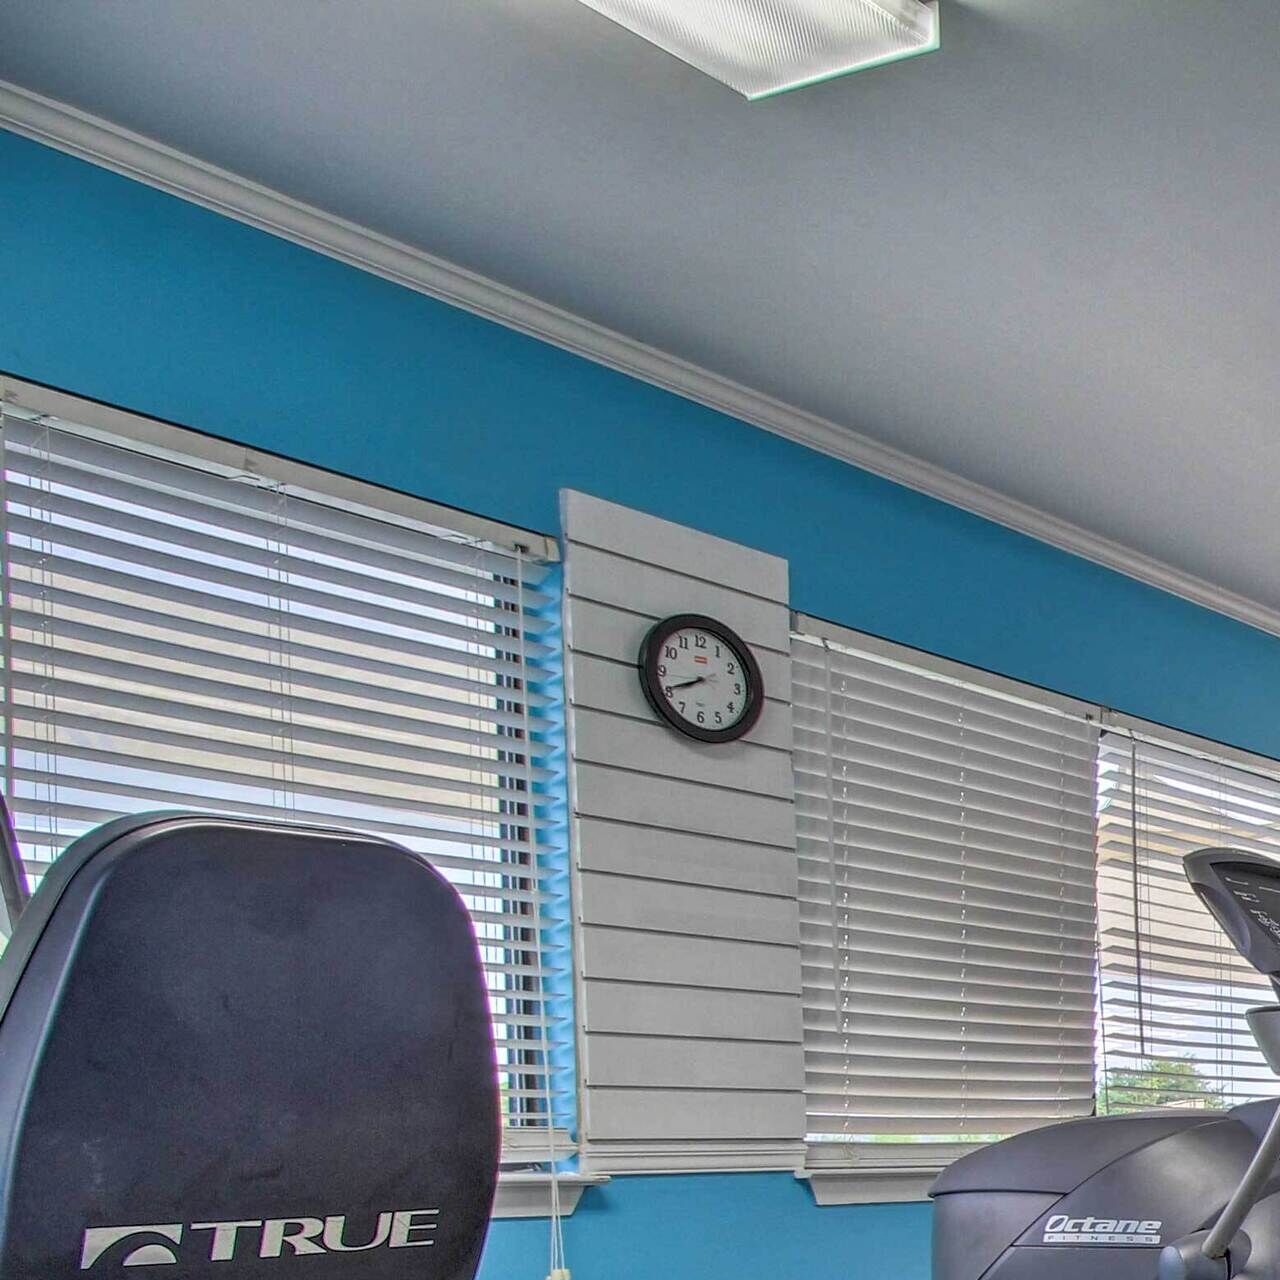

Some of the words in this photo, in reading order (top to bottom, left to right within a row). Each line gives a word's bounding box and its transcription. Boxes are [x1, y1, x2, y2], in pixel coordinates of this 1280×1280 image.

[679, 635, 689, 650] 11
[694, 634, 707, 649] 12
[665, 646, 678, 660] 10
[715, 645, 721, 659] 1
[658, 664, 667, 678] 9
[727, 662, 735, 675] 2
[665, 685, 674, 699] 8
[733, 683, 741, 696] 3
[678, 701, 686, 714] 7
[726, 701, 735, 714] 4
[696, 711, 705, 724] 6
[714, 711, 722, 724] 5
[1045, 1215, 1162, 1233] Octane
[190, 1208, 440, 1262] TRUE
[1047, 1235, 1154, 1243] FITNESS
